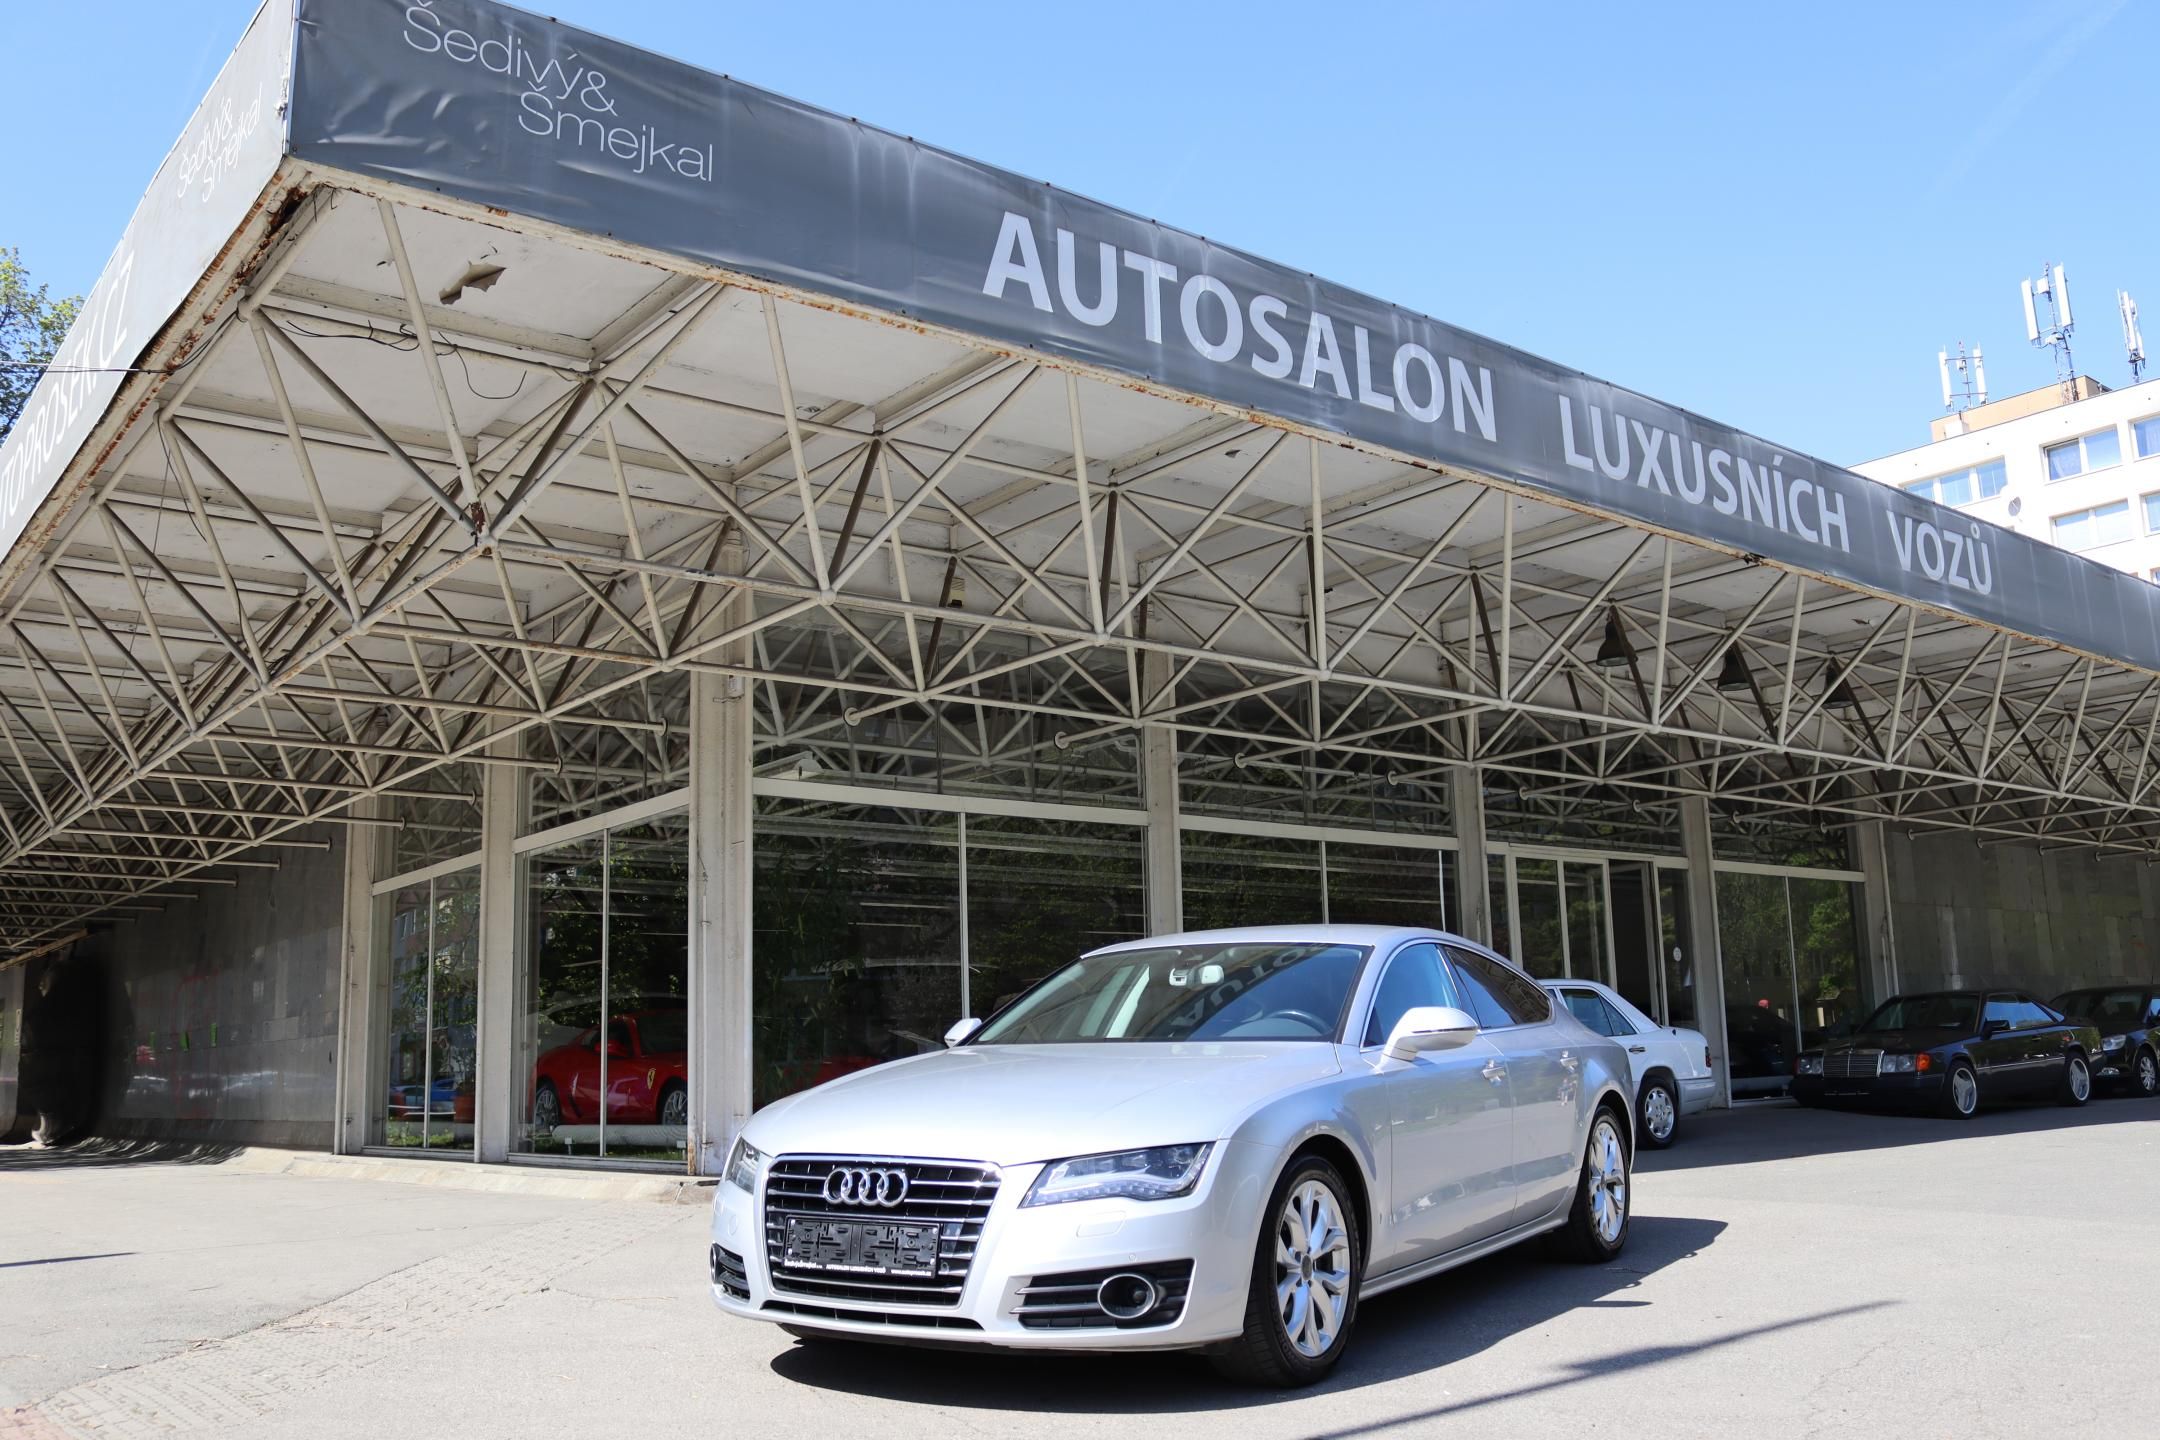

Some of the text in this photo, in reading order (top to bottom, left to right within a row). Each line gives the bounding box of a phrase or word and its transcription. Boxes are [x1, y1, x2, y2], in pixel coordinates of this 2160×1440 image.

[403, 0, 618, 117] Šedivý&
[518, 80, 713, 182] Šmejkal
[0, 249, 135, 529] TOPROSEK.CZ
[982, 210, 1993, 596] AUTOSALON LUXUSNÍCH VOZŮ
